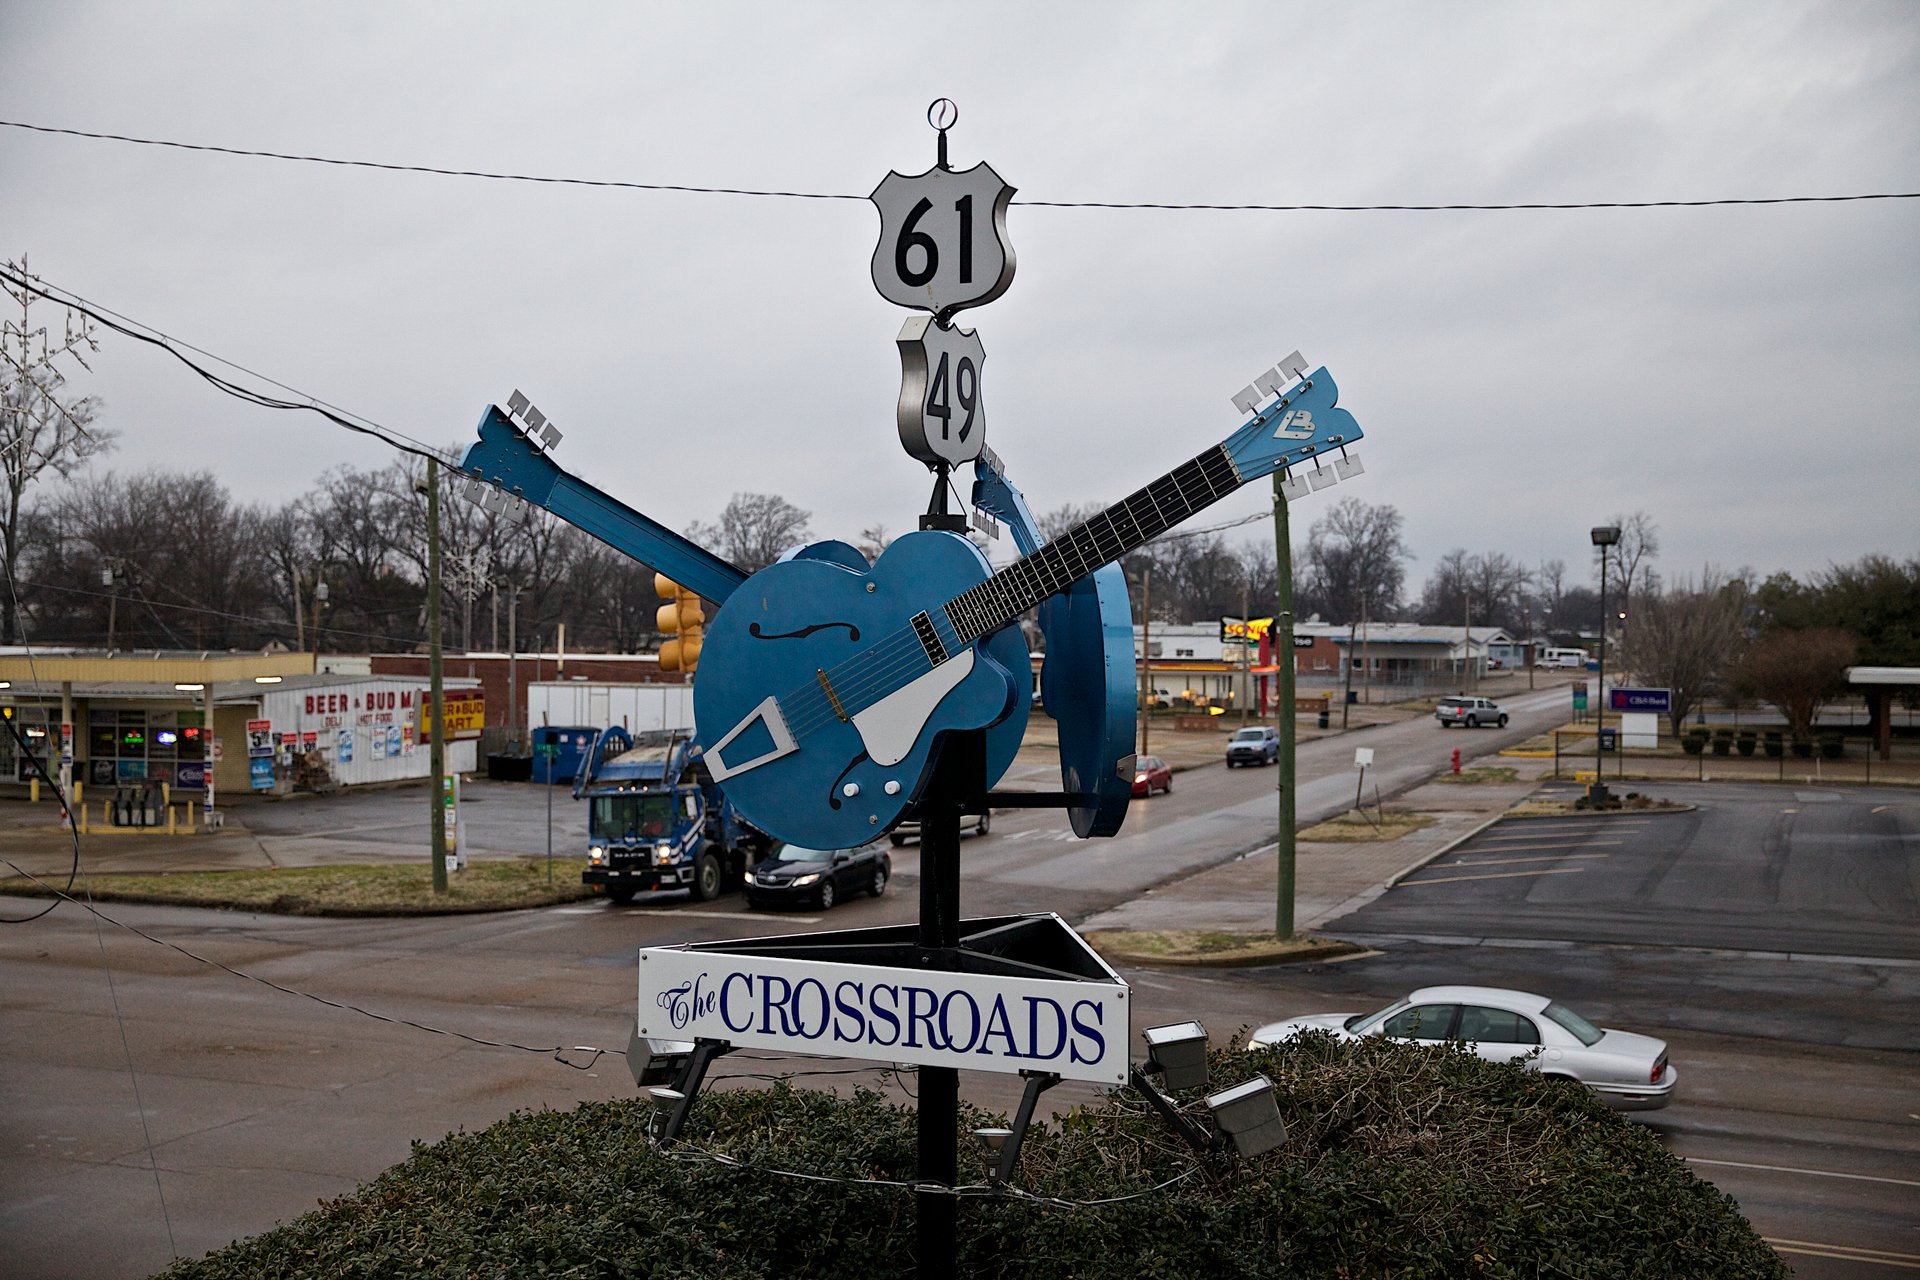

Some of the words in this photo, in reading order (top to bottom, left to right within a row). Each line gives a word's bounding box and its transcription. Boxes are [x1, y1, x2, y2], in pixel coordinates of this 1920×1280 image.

[895, 194, 973, 287] 61
[926, 351, 977, 444] 49
[1228, 623, 1270, 637] SONIC
[1294, 637, 1313, 646] ise
[305, 694, 348, 715] BEER
[366, 691, 395, 711] BUD
[462, 702, 484, 714] BUD
[443, 717, 473, 732] ART
[657, 972, 716, 1029] The
[719, 972, 1106, 1066] CROSSROADS
